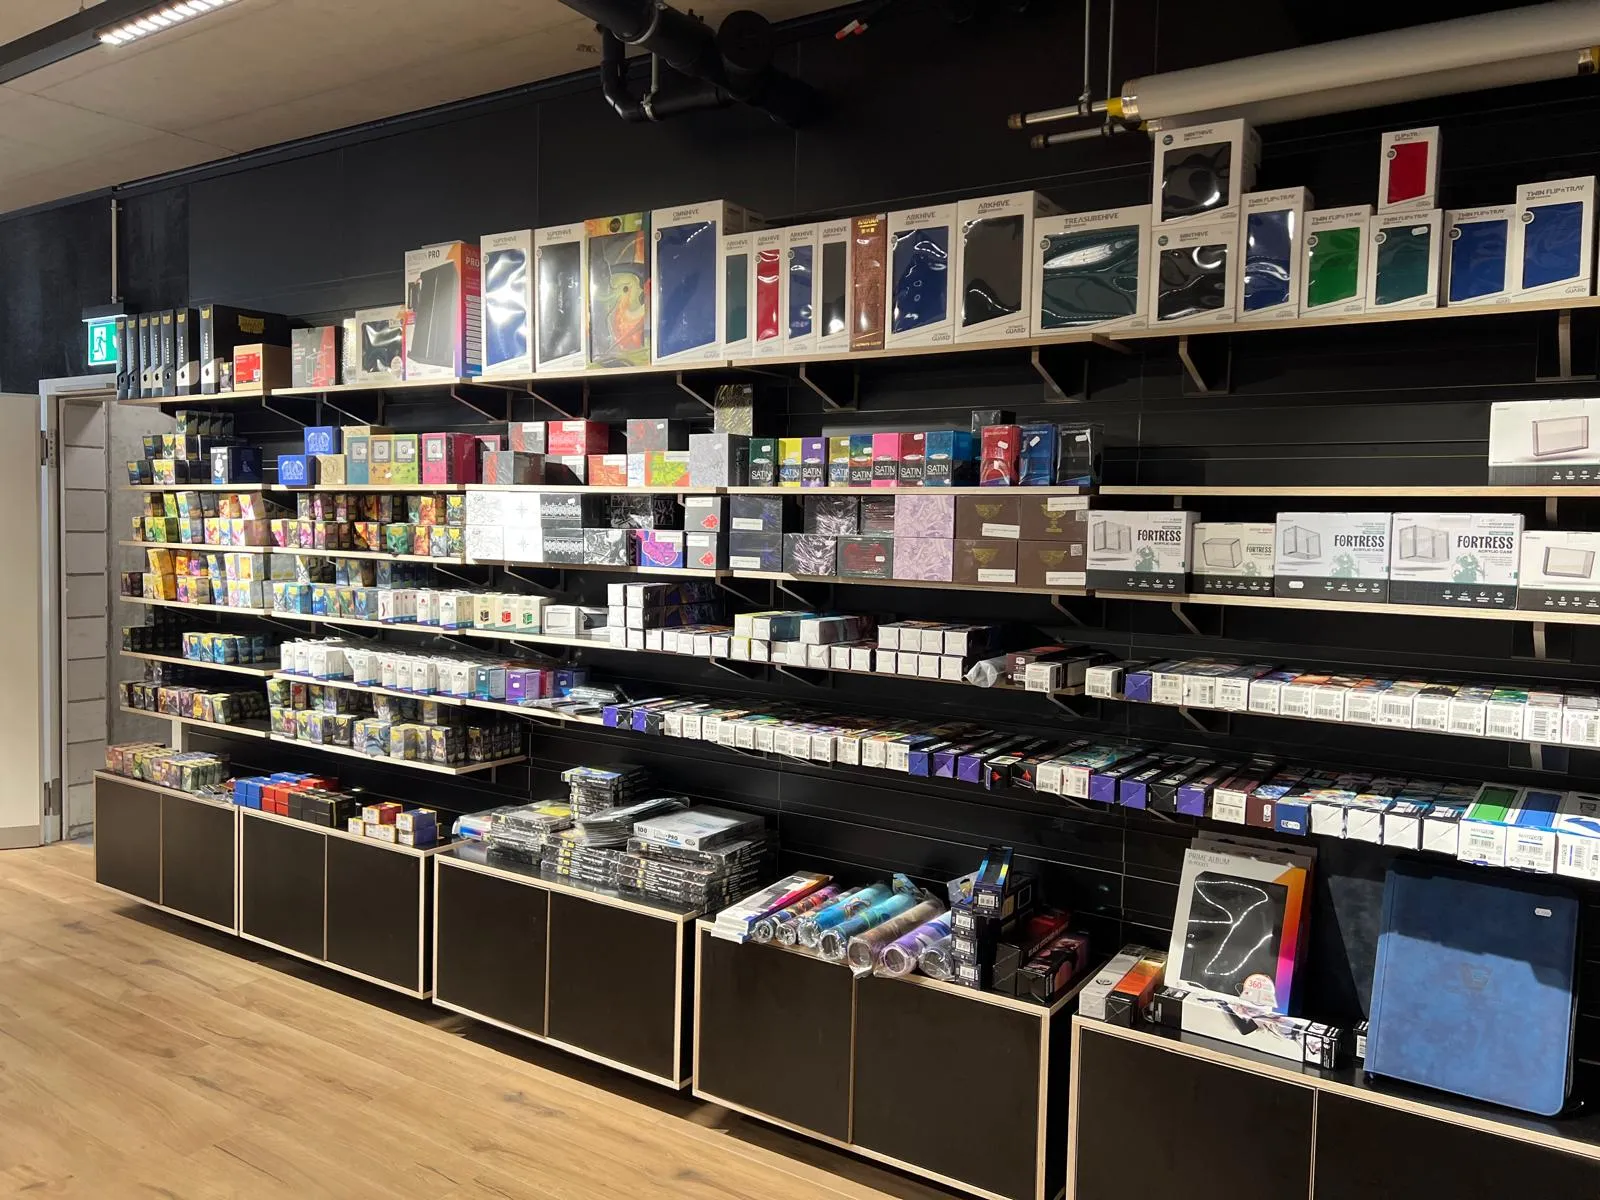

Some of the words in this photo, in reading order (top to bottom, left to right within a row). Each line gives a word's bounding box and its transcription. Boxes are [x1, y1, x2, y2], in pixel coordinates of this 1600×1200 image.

[978, 200, 1010, 210] ARKHIVE
[906, 212, 936, 221] ARKHIVE
[1064, 213, 1119, 225] TREASUREHIVE
[790, 230, 813, 239] ARKHIVE
[823, 226, 847, 235] ARKHIVE
[727, 239, 748, 248] ARKHIVE
[758, 234, 780, 244] ARKHIVE
[428, 250, 440, 259] PRO
[465, 257, 480, 268] PRO
[751, 470, 770, 480] SATIN
[780, 468, 799, 478] SATIN
[802, 467, 822, 477] SATIN
[831, 468, 849, 478] SATIN
[874, 465, 896, 475] SATIN
[901, 468, 922, 477] SATIN
[926, 465, 948, 475] SATIN
[851, 471, 872, 480] SATIN
[1137, 529, 1181, 541] FORTRESS
[1334, 535, 1385, 547] FORTRESS
[1457, 535, 1514, 549] FORTRESS
[637, 826, 648, 834] 100
[1188, 852, 1206, 861] PRIME
[1208, 857, 1230, 865] ALBUM
